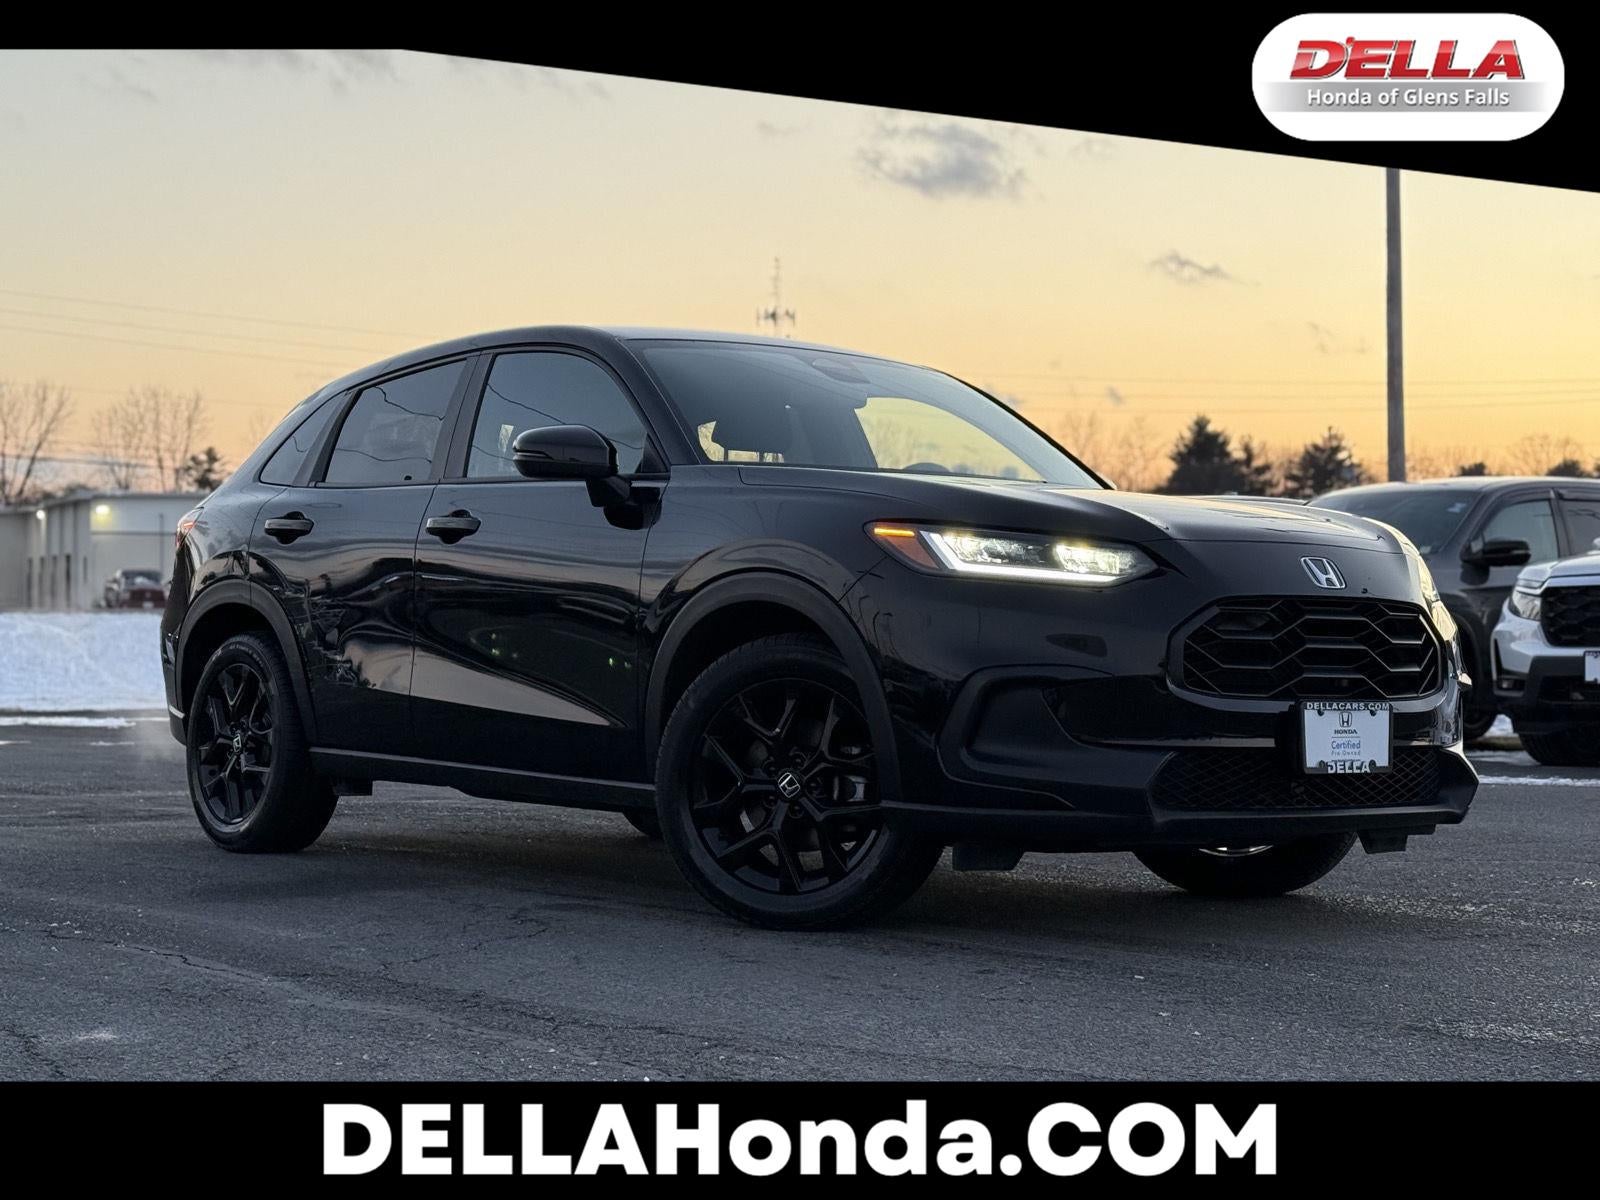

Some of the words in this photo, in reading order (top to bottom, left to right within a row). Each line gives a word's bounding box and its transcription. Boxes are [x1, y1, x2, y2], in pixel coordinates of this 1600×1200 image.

[1307, 702, 1389, 710] DELLACARS.COM
[1331, 740, 1361, 750] Certified
[1328, 761, 1370, 773] DELLA
